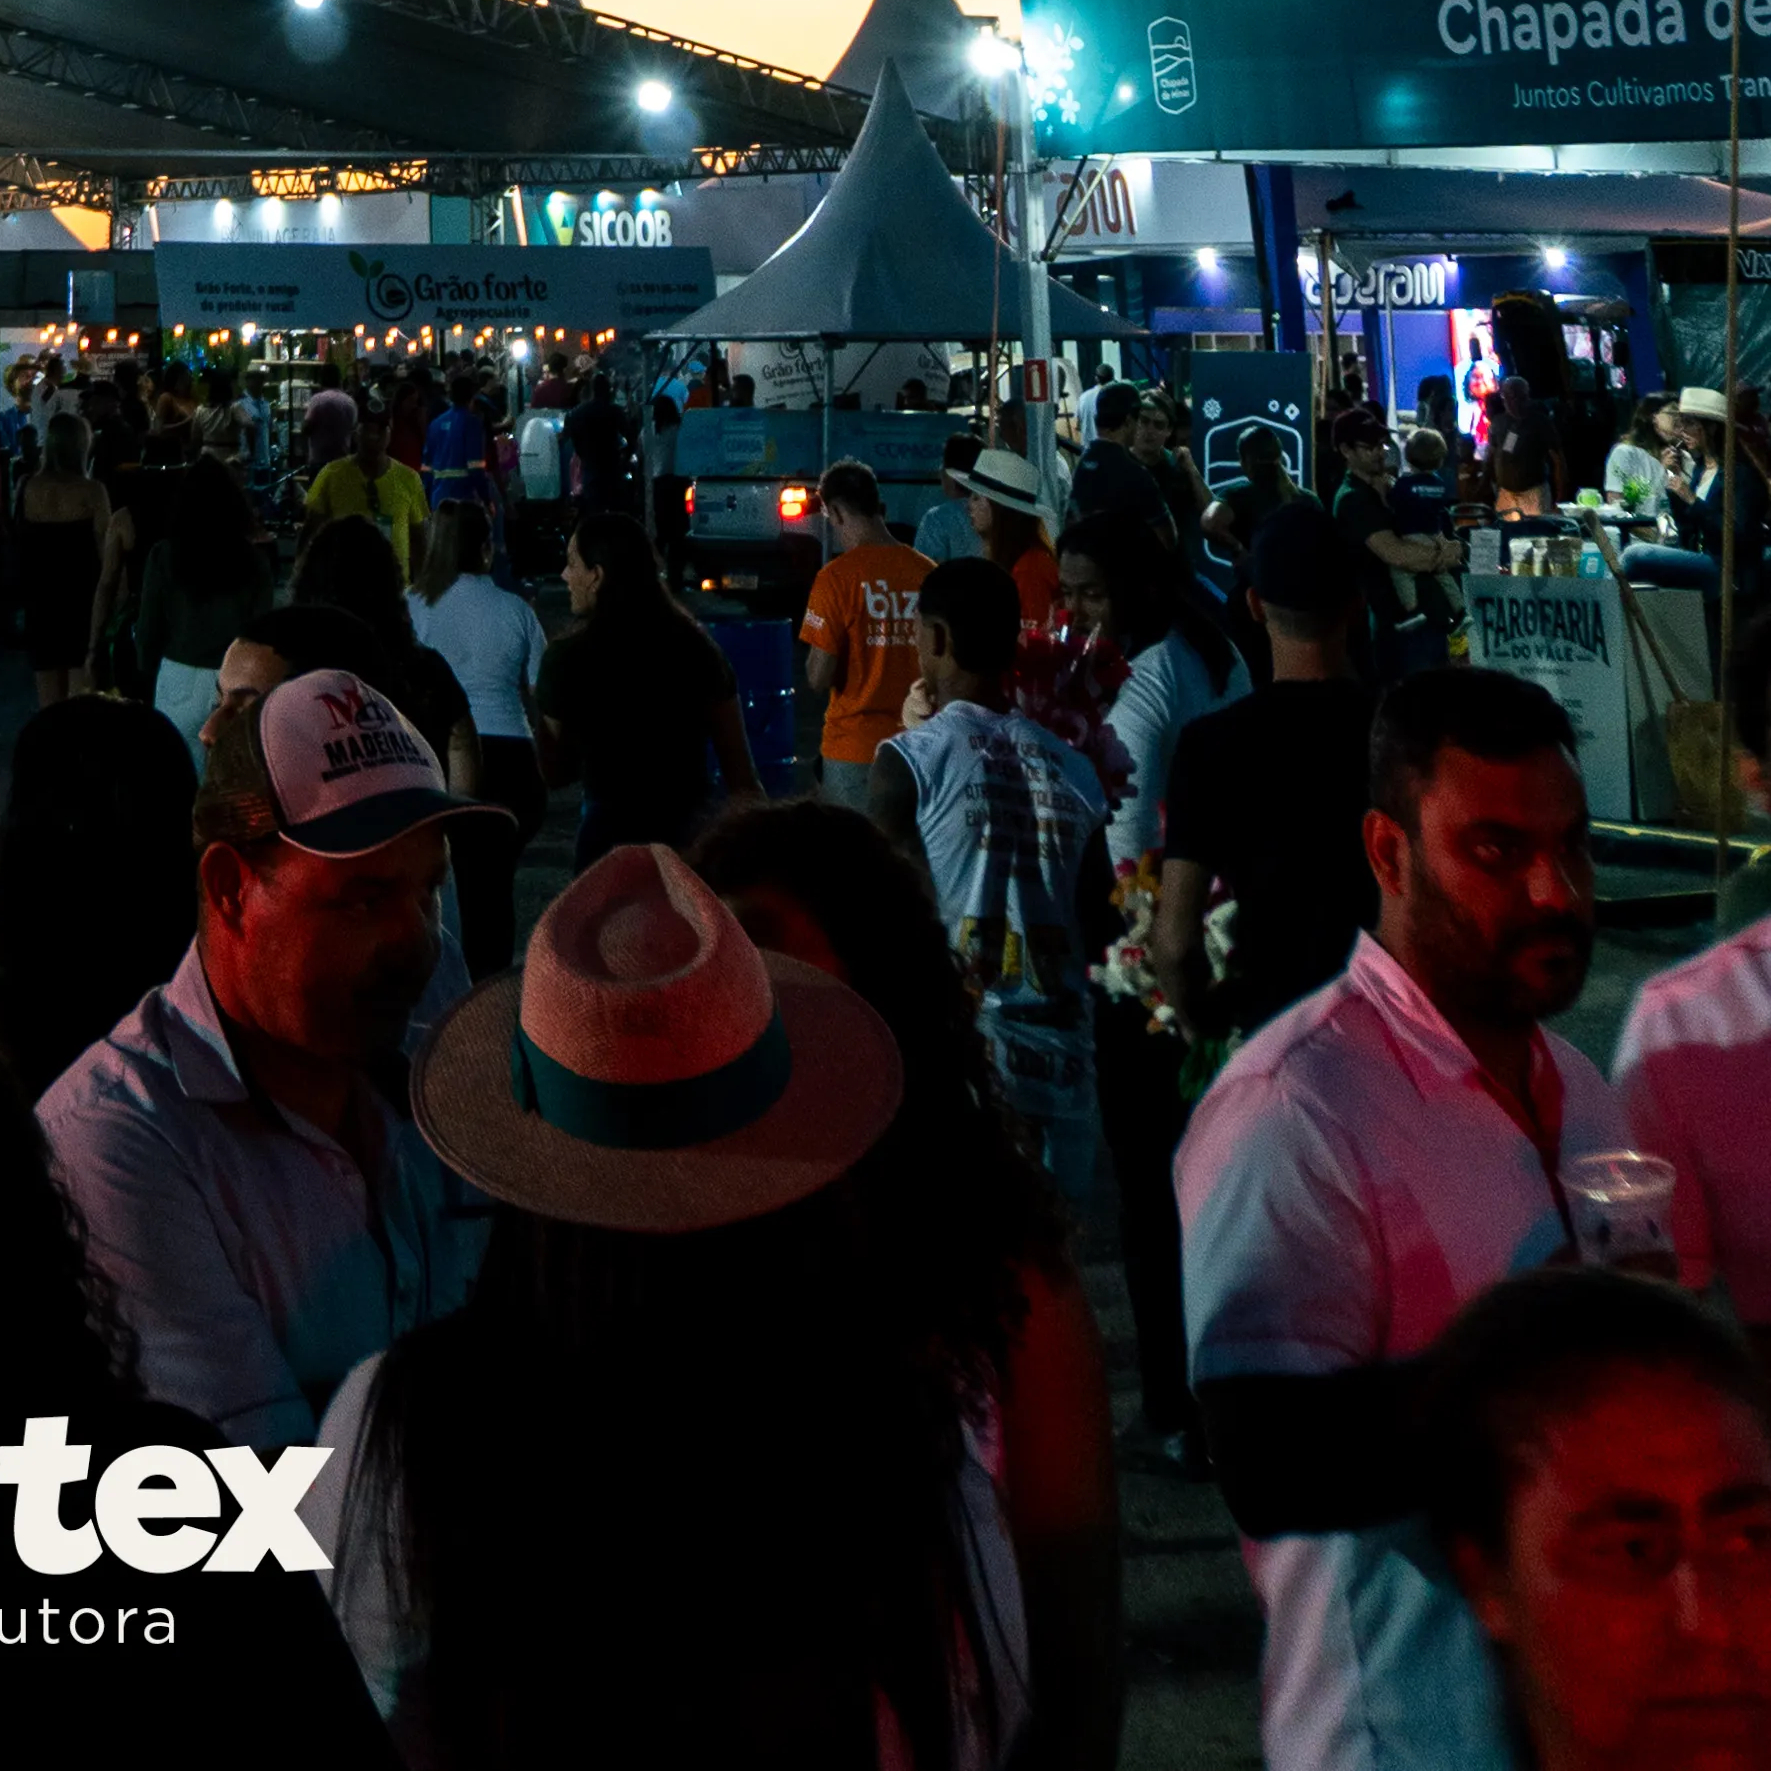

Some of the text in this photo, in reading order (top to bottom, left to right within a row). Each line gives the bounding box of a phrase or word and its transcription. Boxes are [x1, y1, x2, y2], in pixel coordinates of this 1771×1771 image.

[1512, 81, 1581, 109] Juntos
[1586, 76, 1715, 108] Cultivamos
[578, 209, 673, 248] SICOOB
[414, 272, 549, 302] Grão forte
[1475, 596, 1612, 668] FAROFARIA
